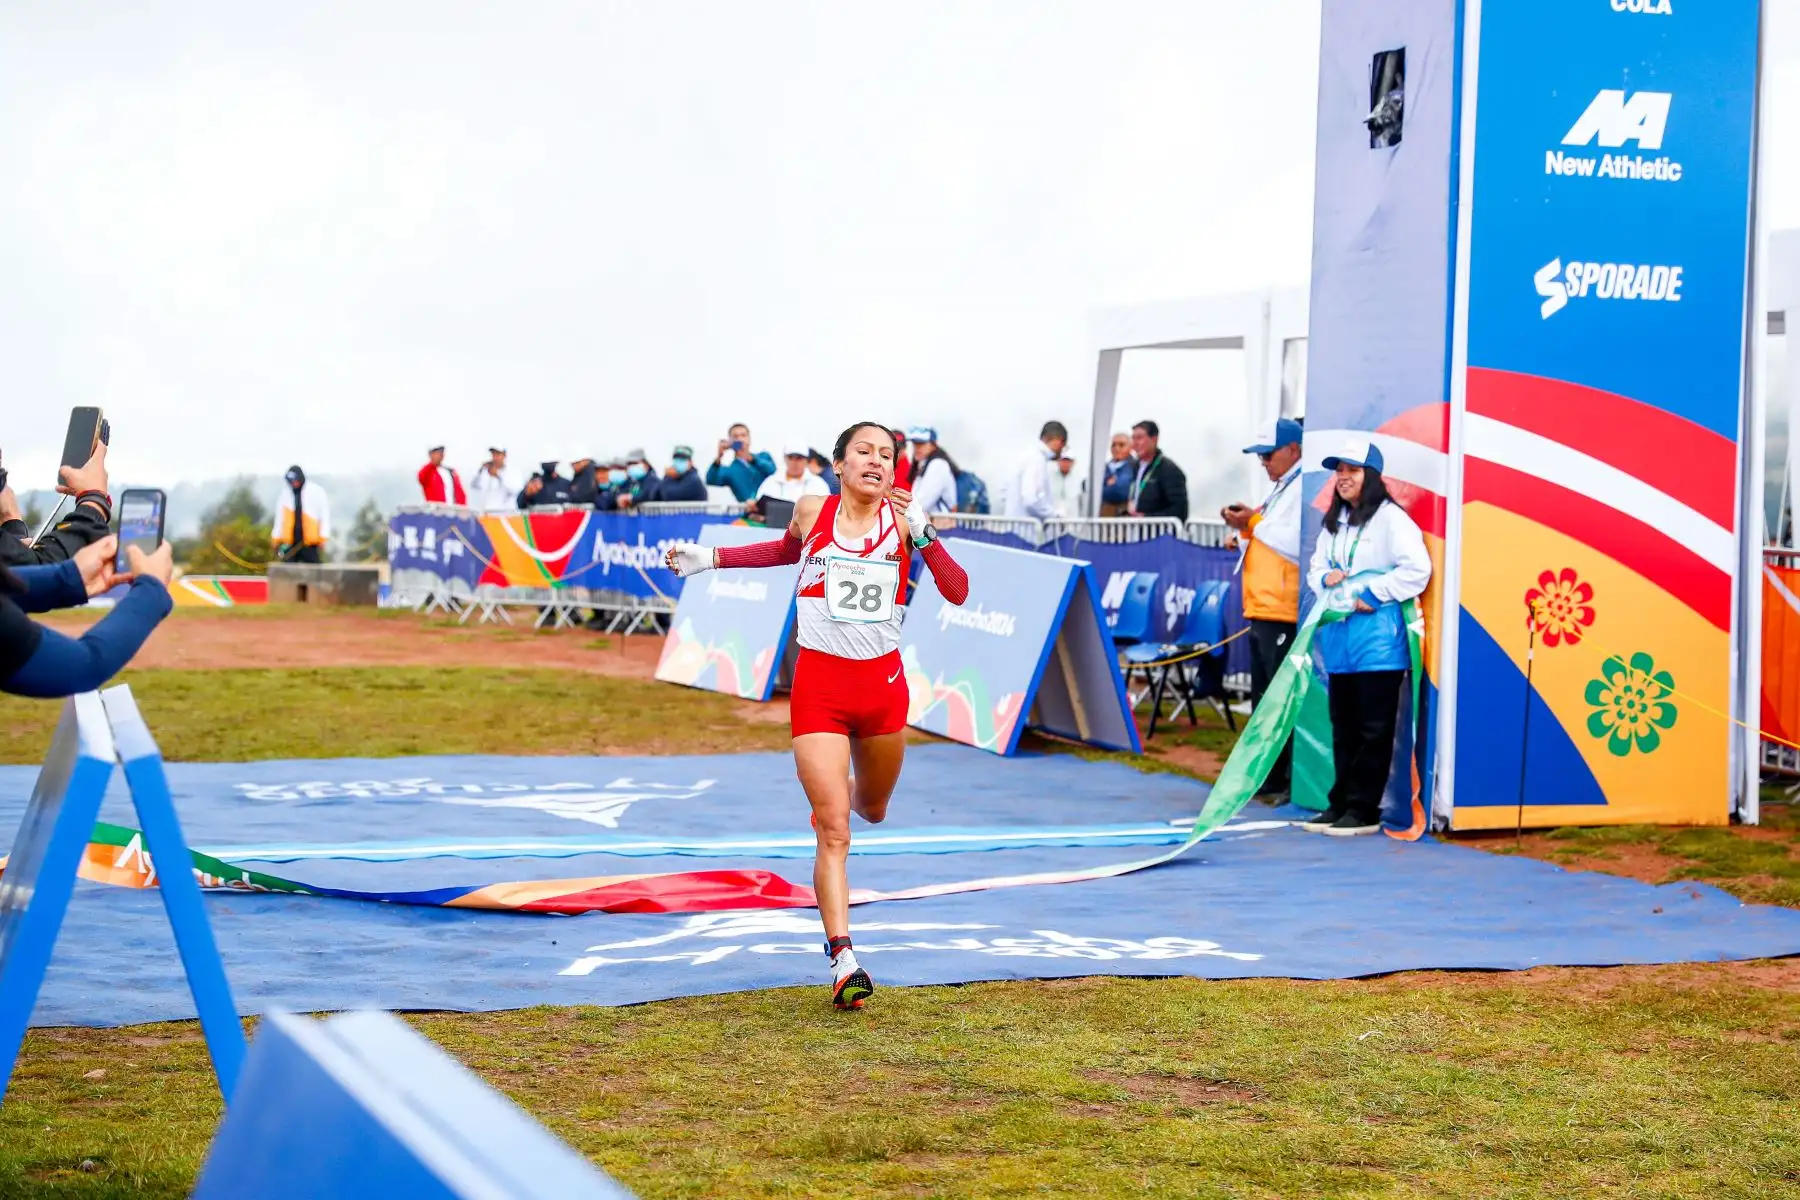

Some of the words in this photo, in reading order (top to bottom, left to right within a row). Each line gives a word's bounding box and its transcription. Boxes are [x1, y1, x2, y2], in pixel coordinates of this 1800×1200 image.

[1610, 0, 1673, 15] COLA
[1545, 150, 1596, 177] New
[1597, 154, 1683, 182] Athletic
[1565, 261, 1684, 301] SPORADE
[838, 580, 882, 612] 28
